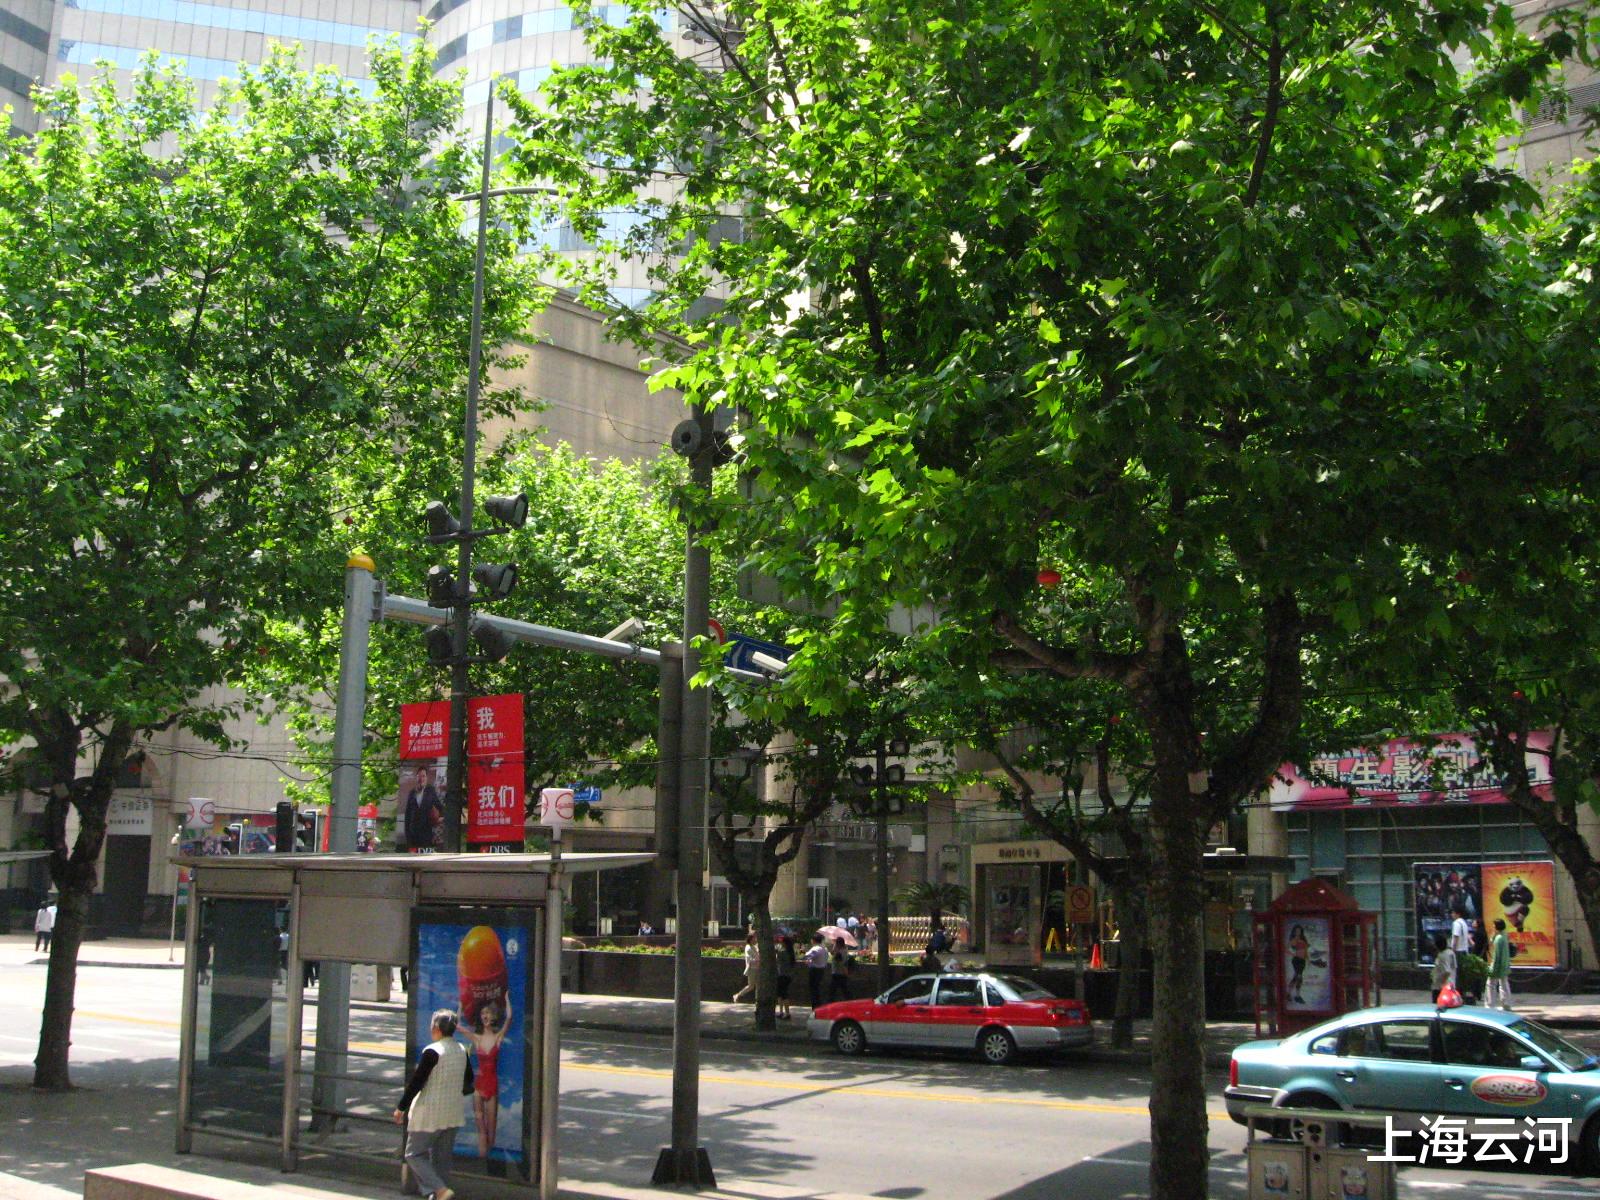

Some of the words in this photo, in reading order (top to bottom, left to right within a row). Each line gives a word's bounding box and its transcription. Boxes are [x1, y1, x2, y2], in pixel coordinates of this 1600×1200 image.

[477, 707, 495, 730] 我
[1309, 752, 1500, 789] 蘭生影剧
[478, 785, 514, 809] 我们
